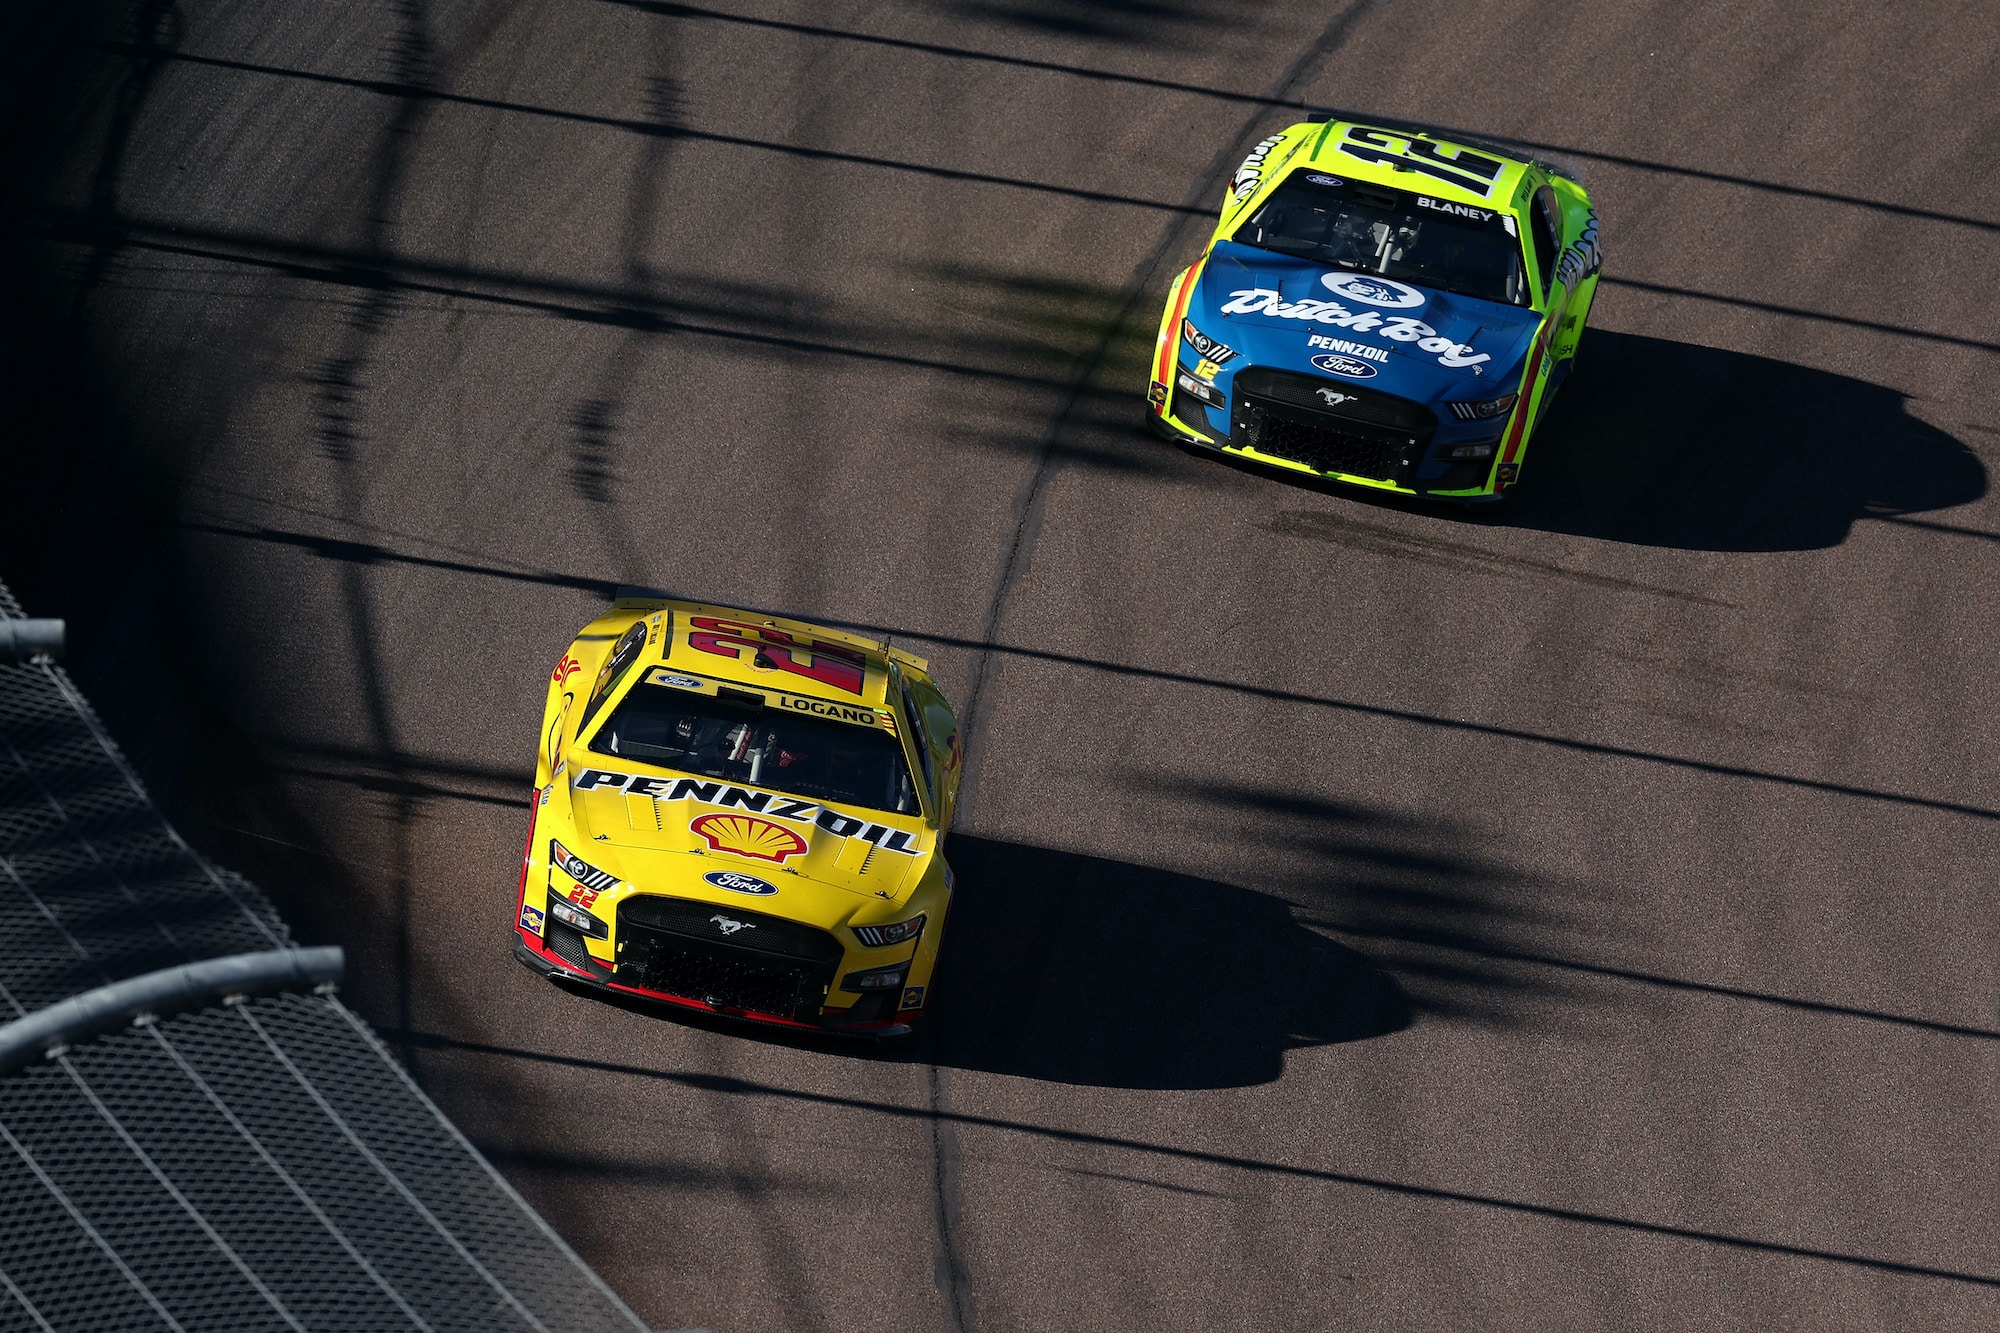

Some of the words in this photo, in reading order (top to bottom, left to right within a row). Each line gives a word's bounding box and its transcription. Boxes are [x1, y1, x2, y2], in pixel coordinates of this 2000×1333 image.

[1336, 126, 1506, 200] 12
[1416, 197, 1493, 222] BLANEY
[1220, 288, 1384, 332] Dutch
[1379, 316, 1491, 368] Boy
[1307, 334, 1389, 364] PENNZOIL
[1194, 358, 1220, 380] 12
[1322, 355, 1364, 376] Ford
[688, 616, 866, 697] 22
[781, 696, 875, 725] LOGANO
[571, 768, 928, 857] PENNZOIL
[567, 884, 599, 909] 22
[716, 872, 764, 894] Ford
